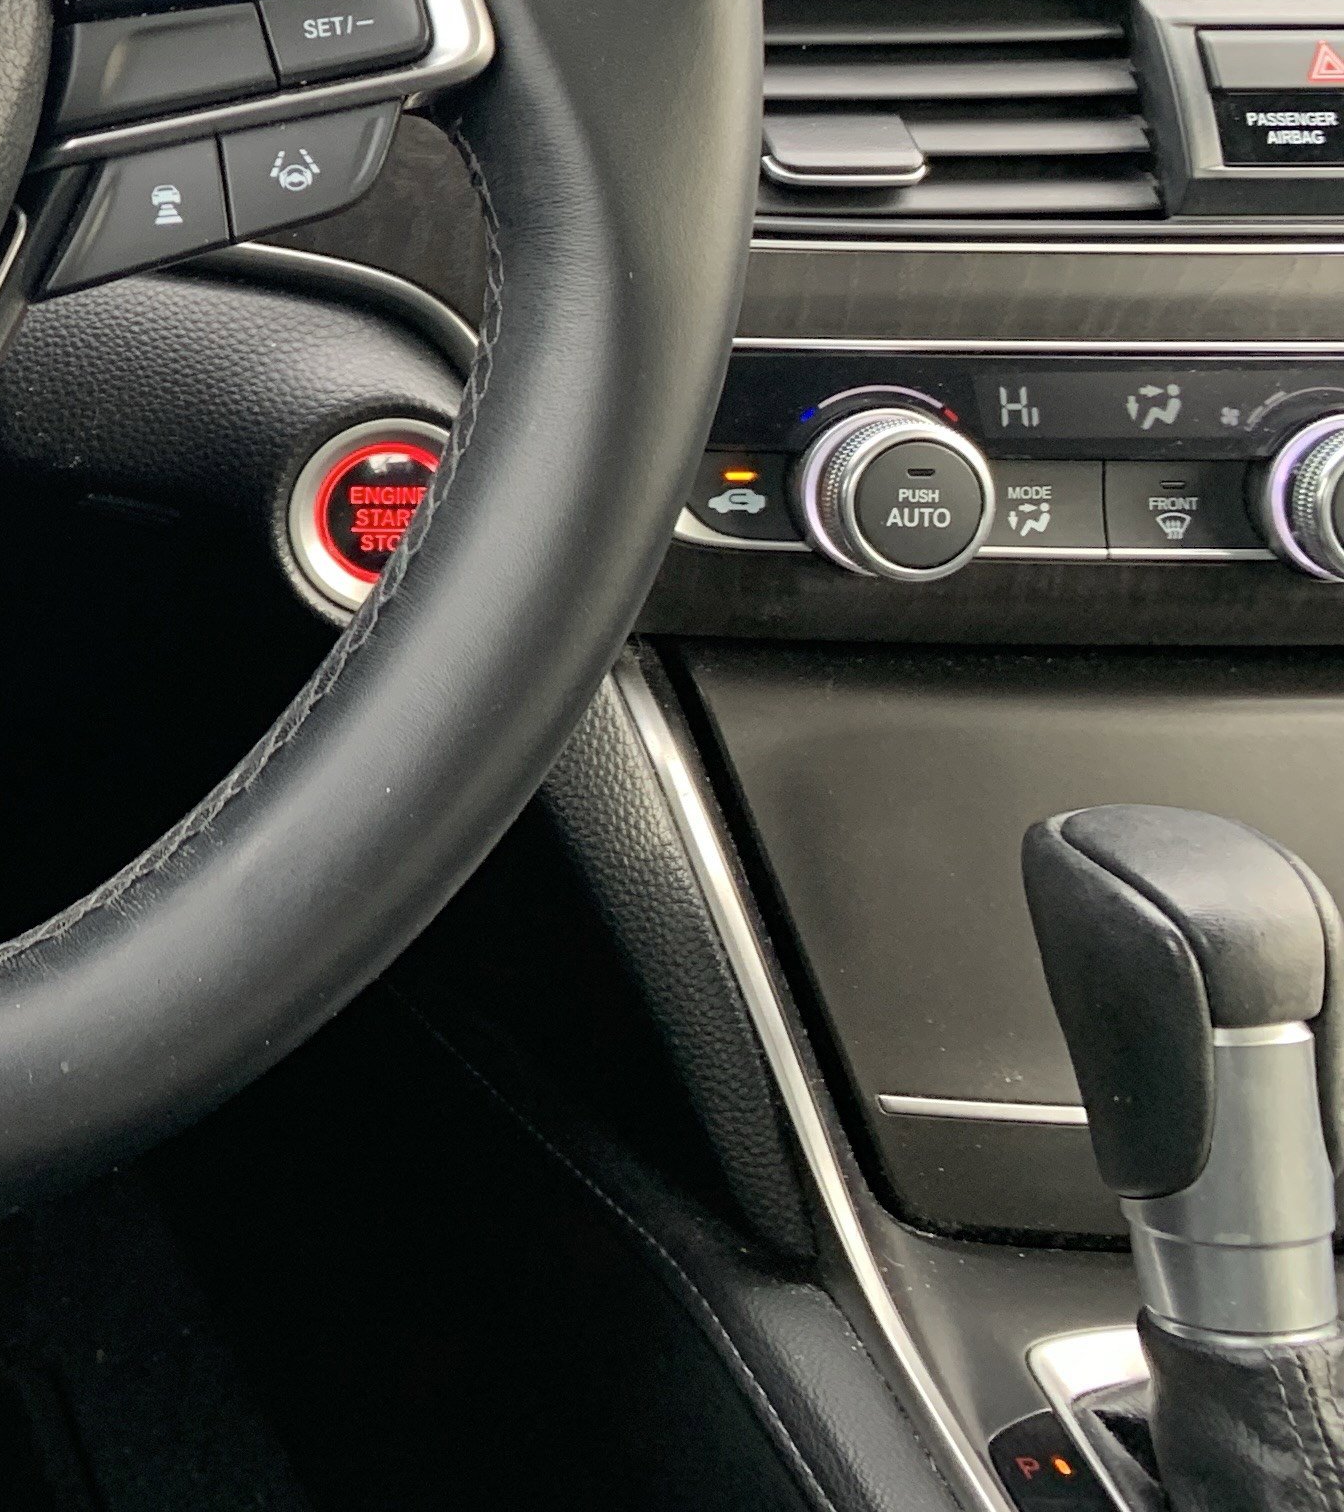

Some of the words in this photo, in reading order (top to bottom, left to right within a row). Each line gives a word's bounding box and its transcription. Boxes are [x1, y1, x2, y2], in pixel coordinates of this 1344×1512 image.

[1245, 112, 1339, 126] PASSENGER
[1267, 130, 1327, 145] AIRBAG
[897, 489, 941, 504] PUSH
[1007, 486, 1053, 500] MODE
[1148, 497, 1199, 512] FRONT
[355, 508, 417, 527] STAR
[885, 507, 953, 529] AUTO
[360, 534, 401, 552] STO
[1016, 1457, 1039, 1479] P
